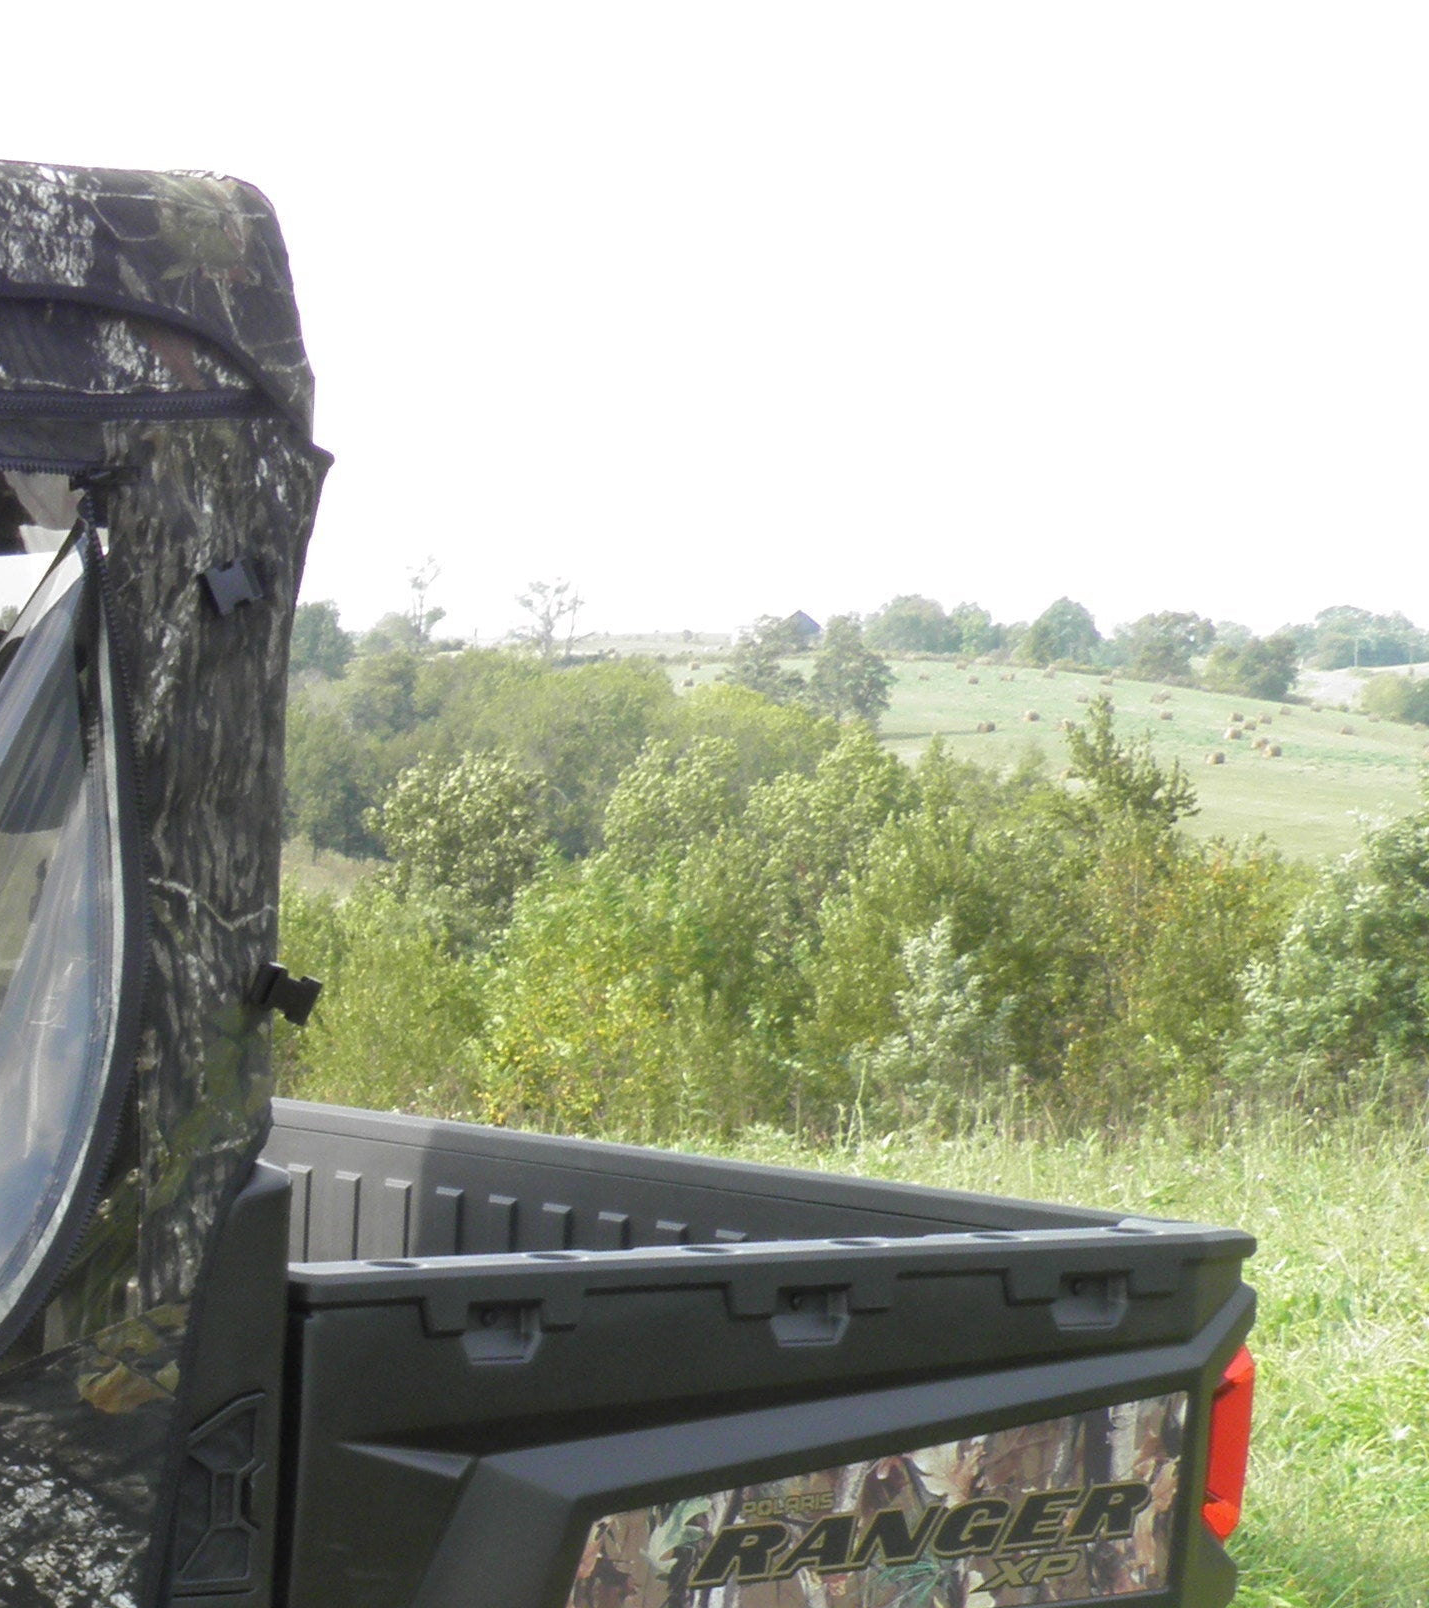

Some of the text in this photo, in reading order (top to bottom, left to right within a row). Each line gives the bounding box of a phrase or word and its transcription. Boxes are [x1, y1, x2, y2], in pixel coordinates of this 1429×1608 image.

[741, 1492, 834, 1518] POLARIS
[688, 1480, 1153, 1588] RANGER
[969, 1549, 1087, 1594] XP
